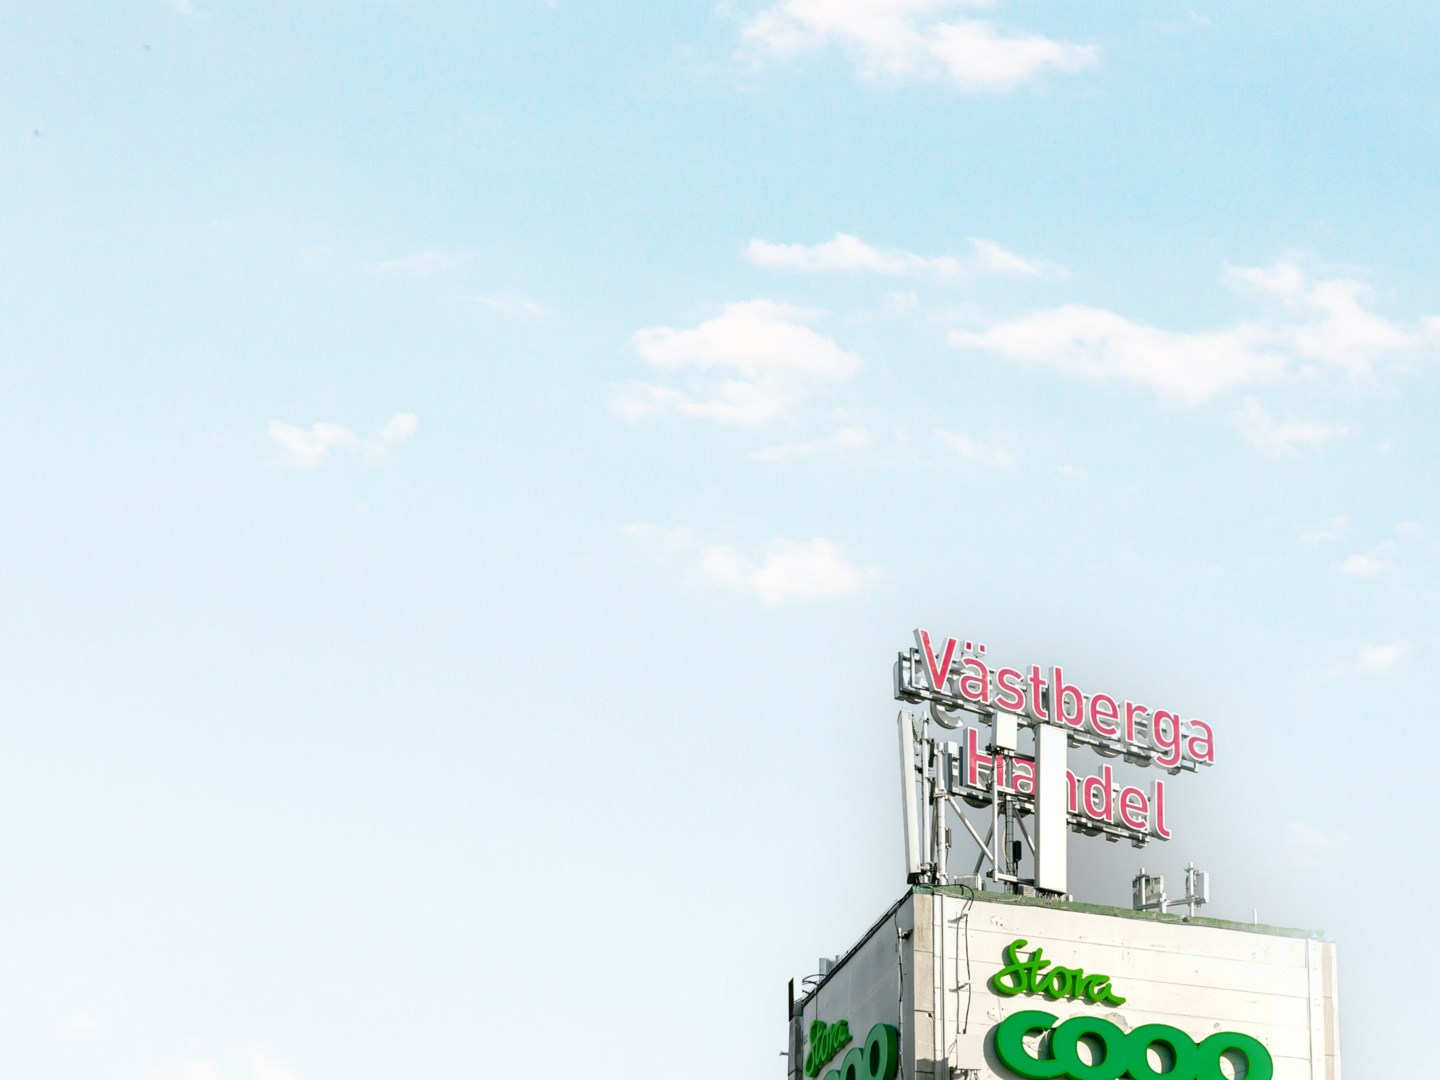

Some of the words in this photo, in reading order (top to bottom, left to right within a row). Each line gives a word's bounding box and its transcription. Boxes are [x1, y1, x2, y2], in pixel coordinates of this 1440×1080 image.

[914, 628, 1215, 768] Västberga
[993, 939, 1126, 1006] Stora
[804, 1019, 853, 1077] Stora
